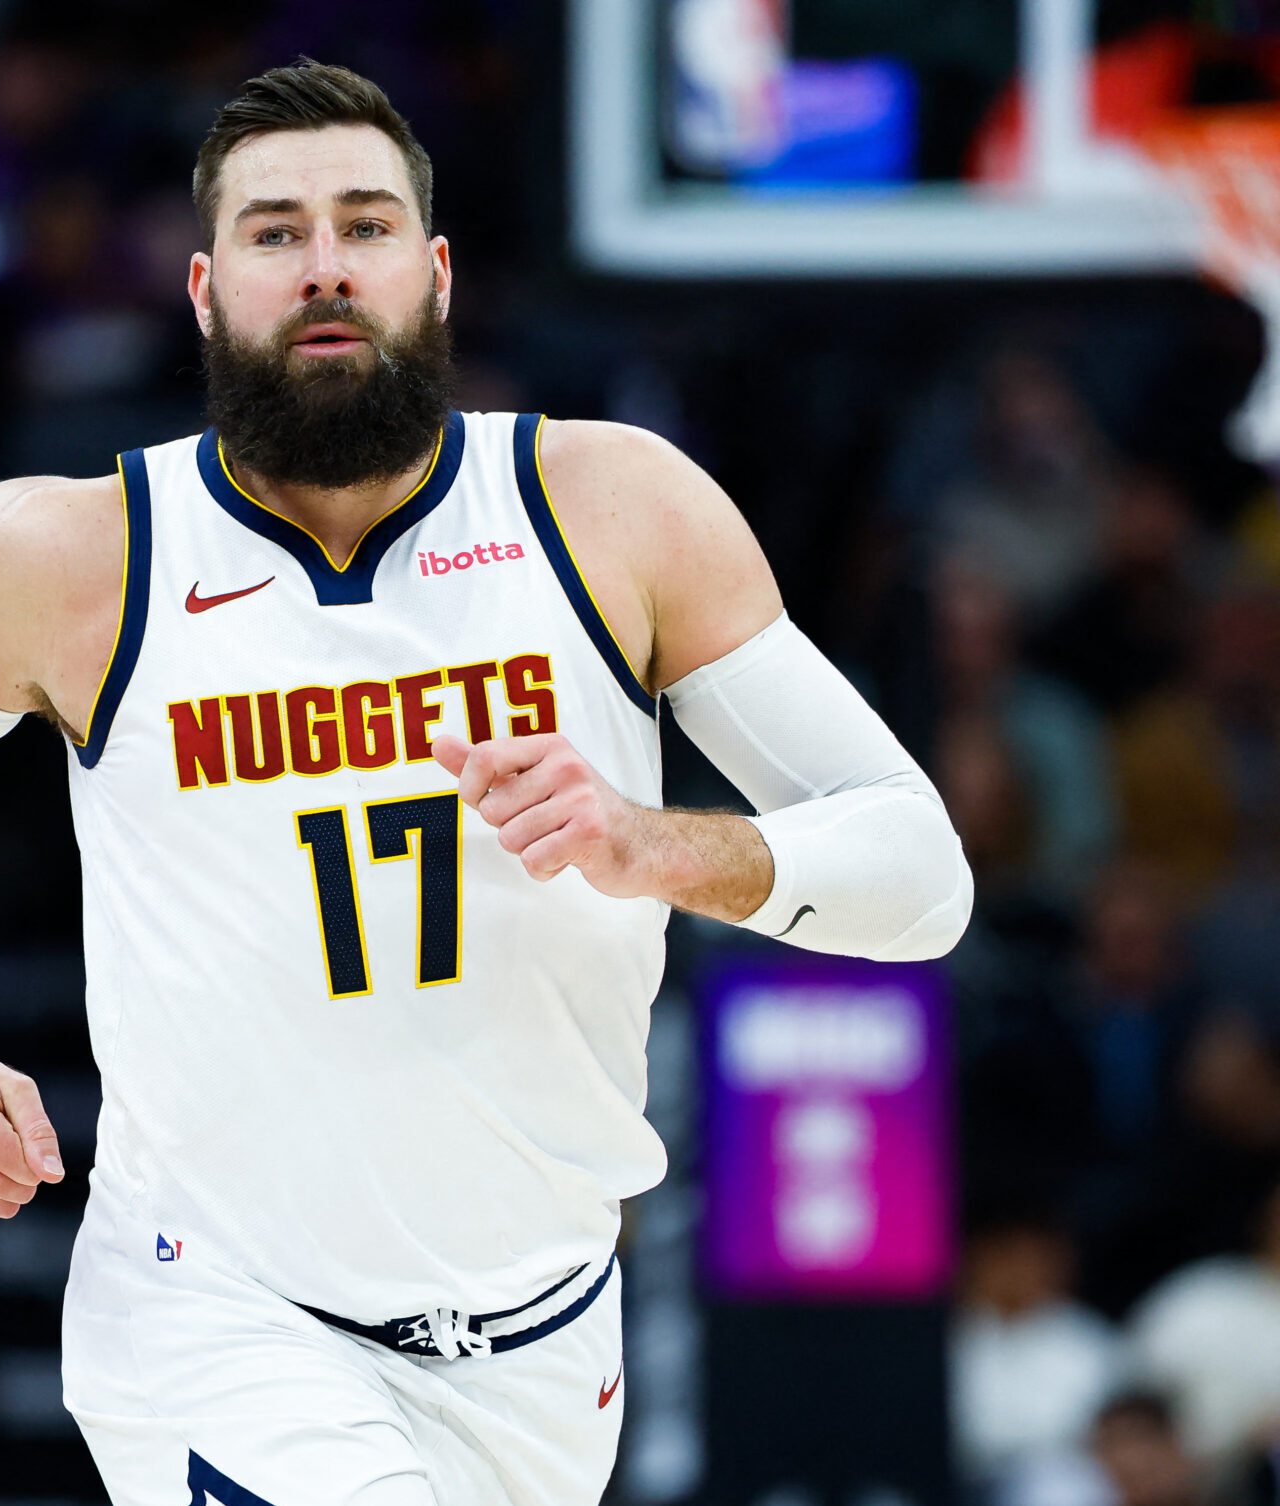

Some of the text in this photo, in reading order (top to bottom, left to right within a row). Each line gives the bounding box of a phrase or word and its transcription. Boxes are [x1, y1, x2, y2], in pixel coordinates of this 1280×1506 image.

[418, 542, 525, 577] ibotta
[167, 653, 559, 791] NUGGETS
[293, 789, 462, 1000] 17
[158, 1247, 172, 1259] NBA
